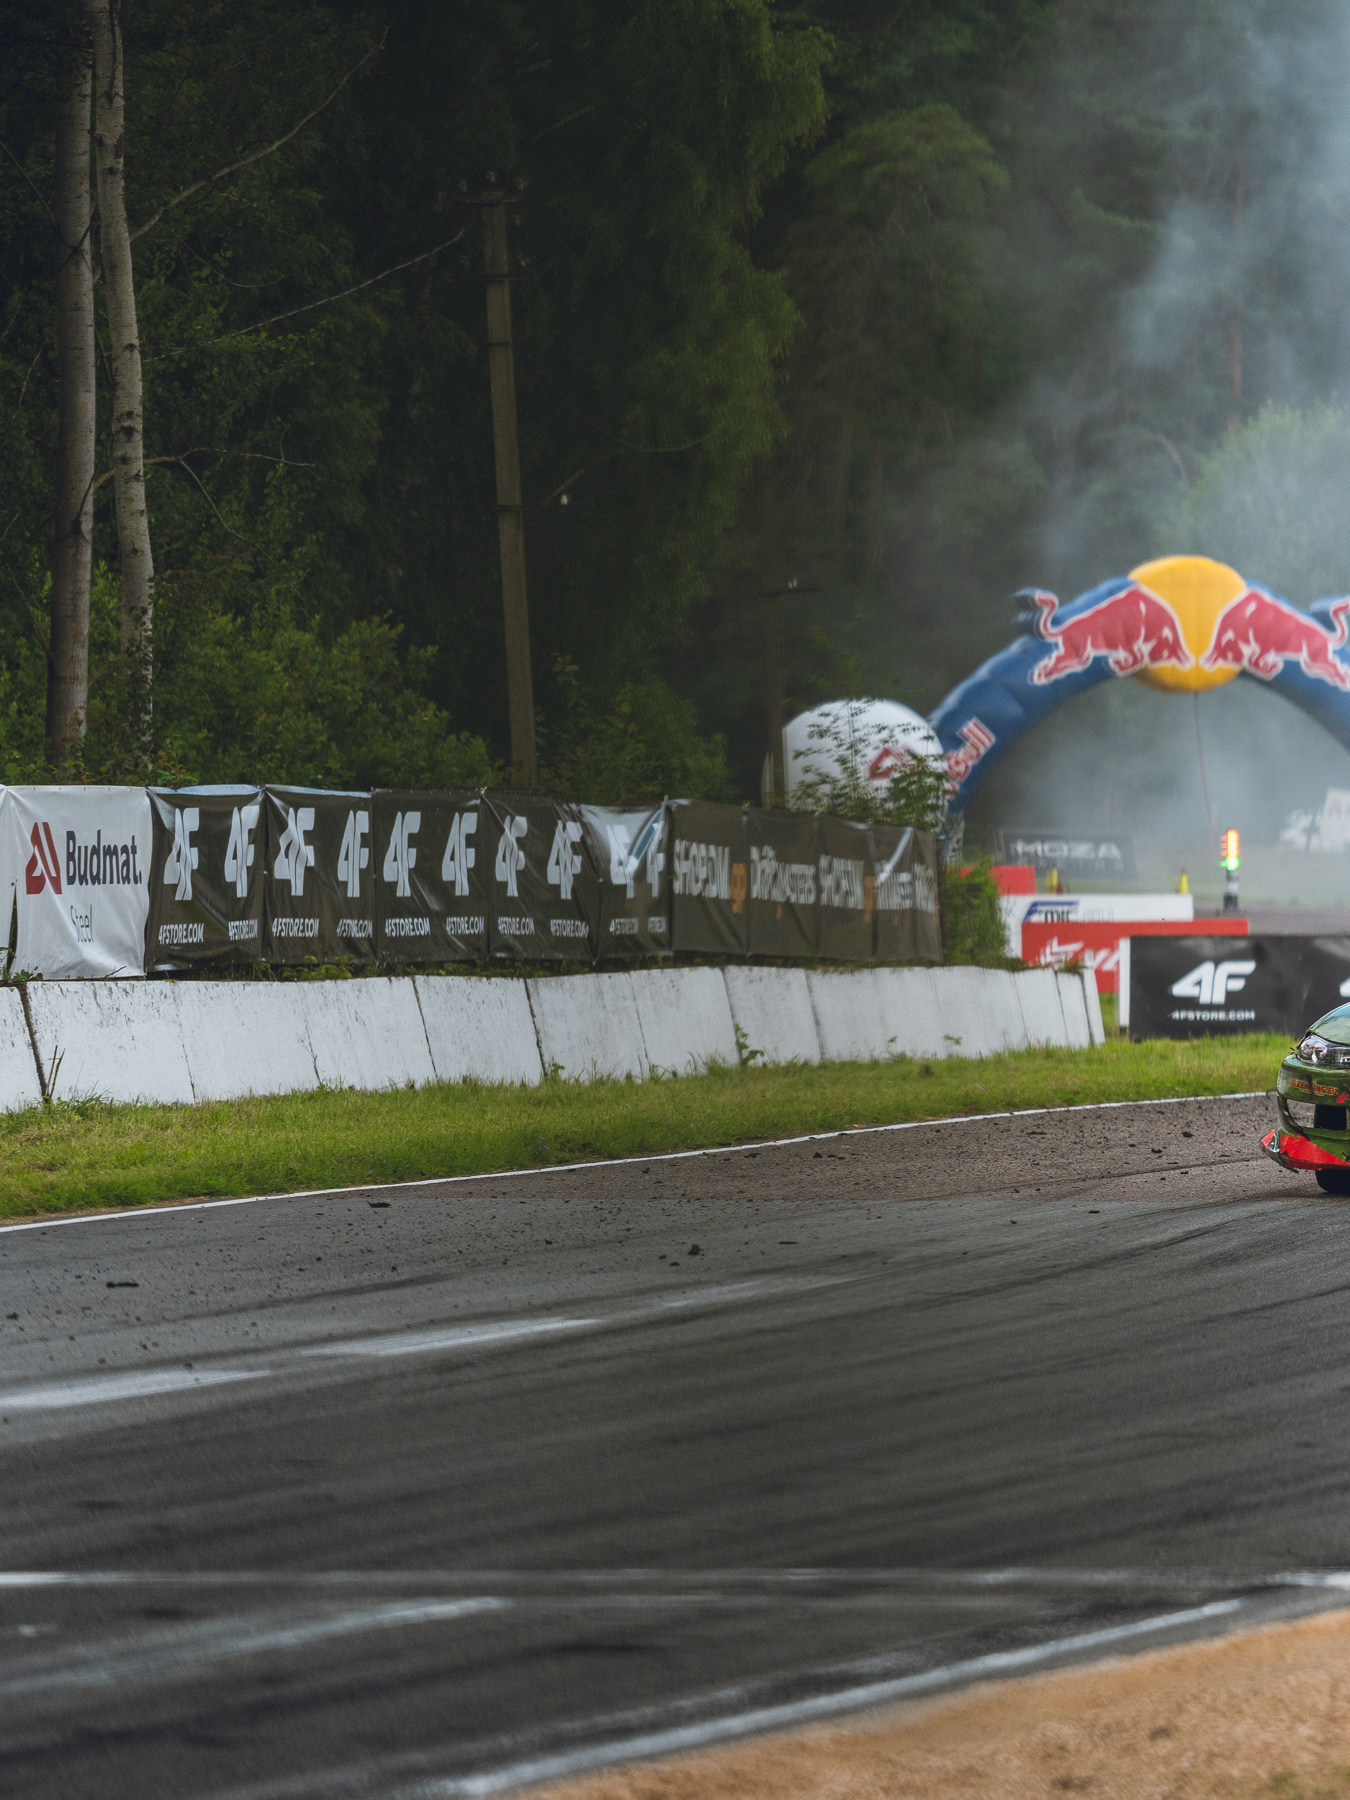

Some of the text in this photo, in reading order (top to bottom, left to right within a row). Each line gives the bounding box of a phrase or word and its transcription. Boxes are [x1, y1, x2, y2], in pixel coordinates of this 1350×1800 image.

[164, 808, 199, 900] 4F
[224, 805, 260, 897] 4F
[274, 807, 315, 896] 4F
[337, 810, 370, 897] 4F
[383, 811, 421, 897] 4F
[442, 812, 477, 896] 4F
[495, 816, 528, 897] 4F
[547, 820, 583, 899] 4F
[1016, 841, 1121, 859] MOZA
[158, 923, 204, 944] 4FSTORE.COM
[272, 918, 319, 937] 4FSTORE.COM
[384, 918, 431, 937] 4FSTORE.COM
[446, 917, 485, 935] 4FSTORE.COM
[1170, 1009, 1256, 1021] 4FSTORE.COM
[1171, 960, 1256, 1005] 4F
